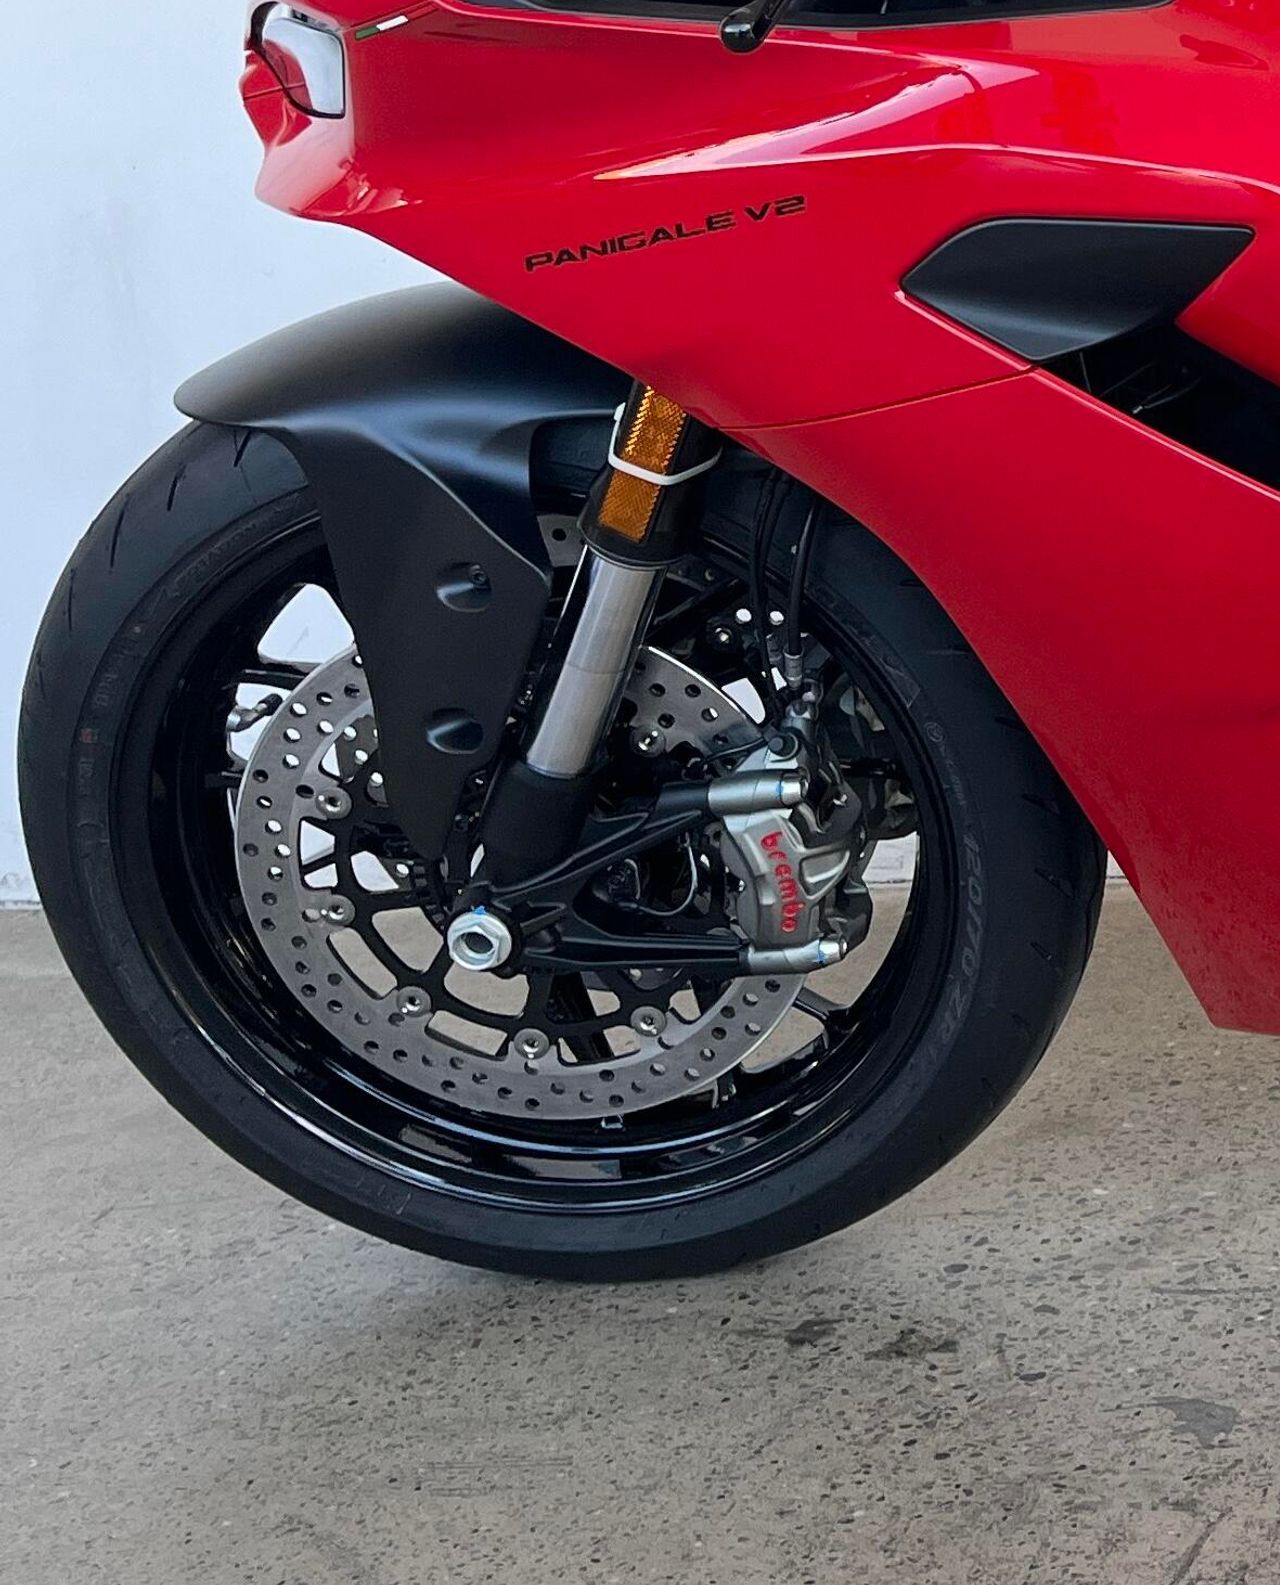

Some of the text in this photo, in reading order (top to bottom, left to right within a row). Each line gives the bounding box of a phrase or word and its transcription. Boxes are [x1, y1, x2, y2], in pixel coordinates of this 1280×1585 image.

[525, 195, 805, 271] PANIGALE V2
[761, 831, 805, 933] brembo
